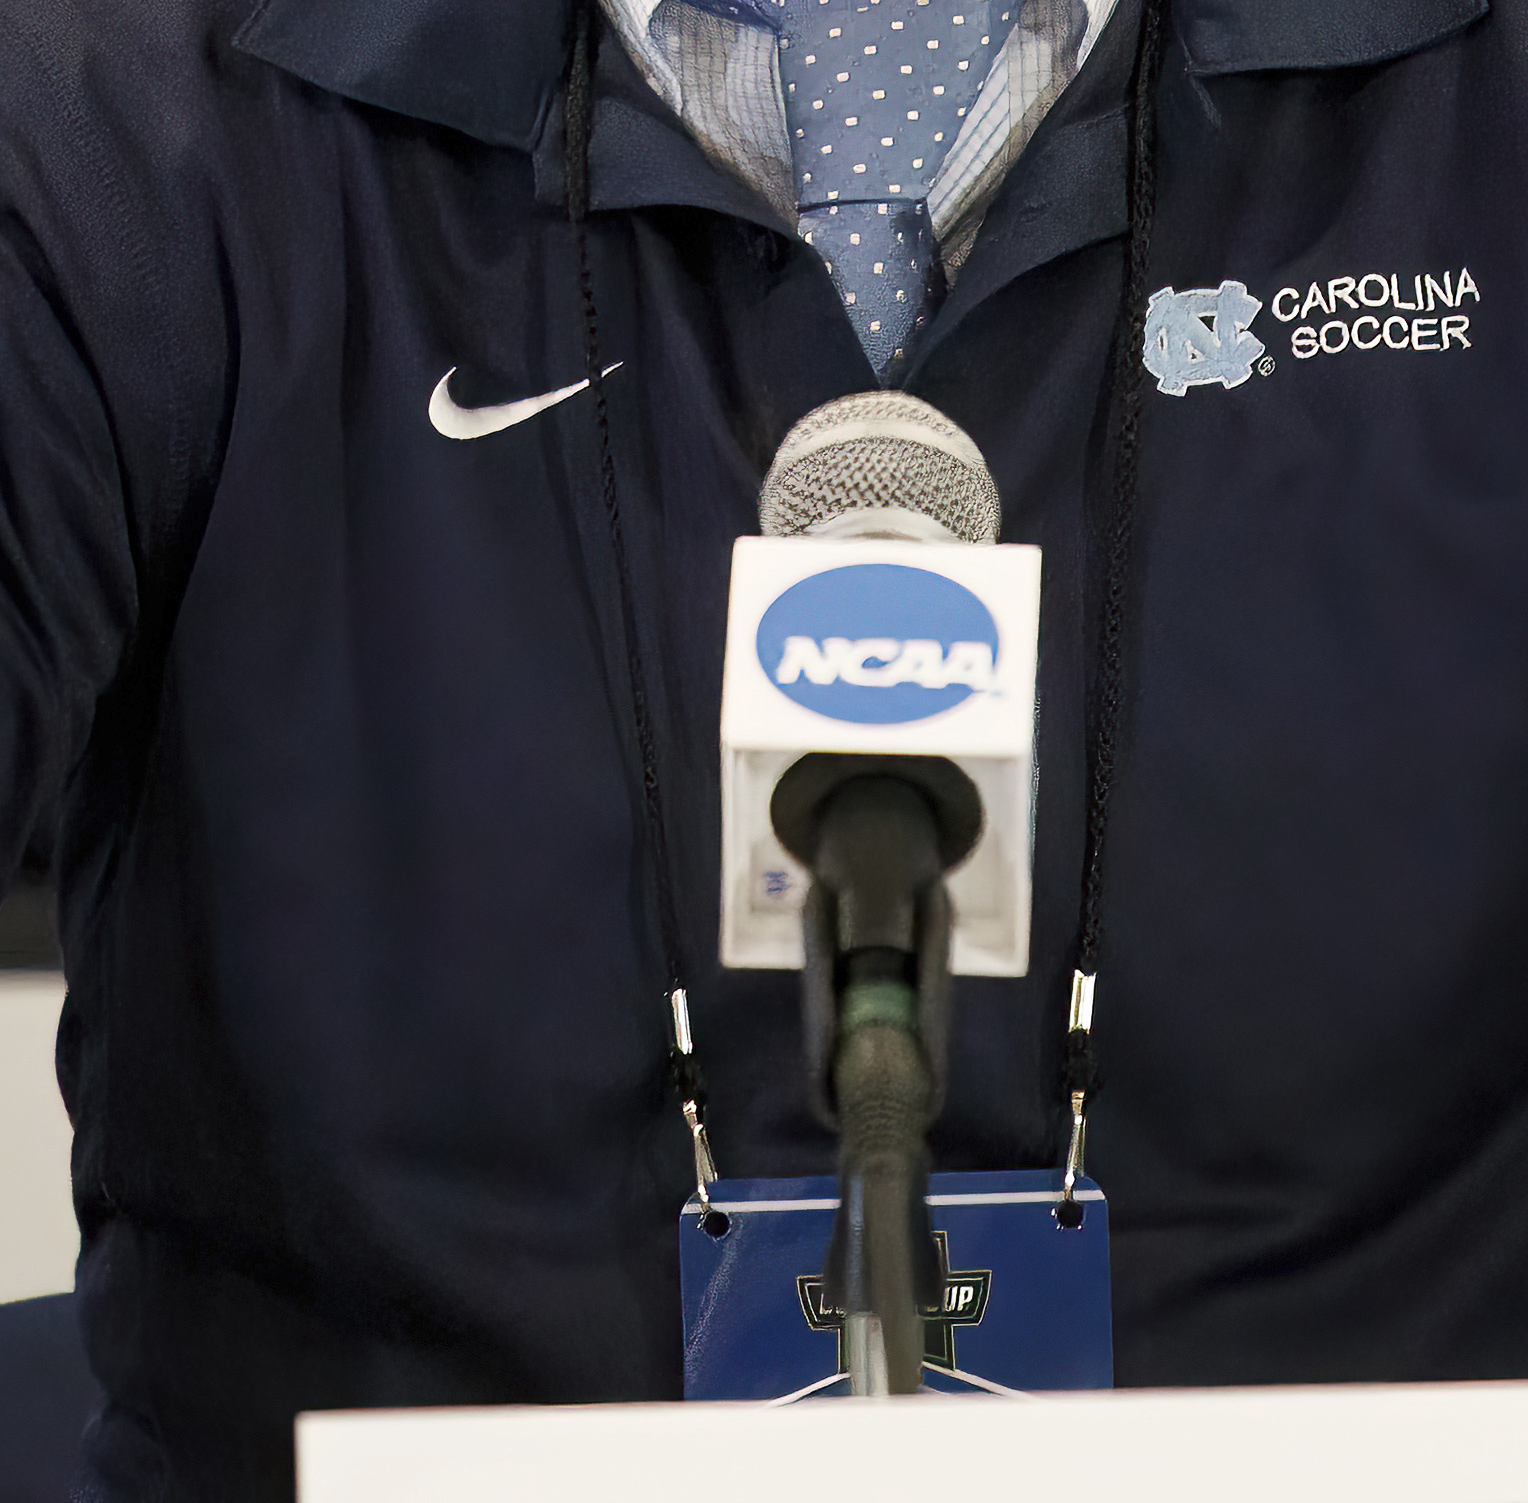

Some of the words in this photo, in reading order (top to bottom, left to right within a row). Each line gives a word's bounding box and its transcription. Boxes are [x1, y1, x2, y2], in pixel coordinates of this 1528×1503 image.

[1272, 267, 1480, 322] CAROLINA
[1291, 315, 1472, 359] SOCCER
[776, 635, 996, 689] NCAA
